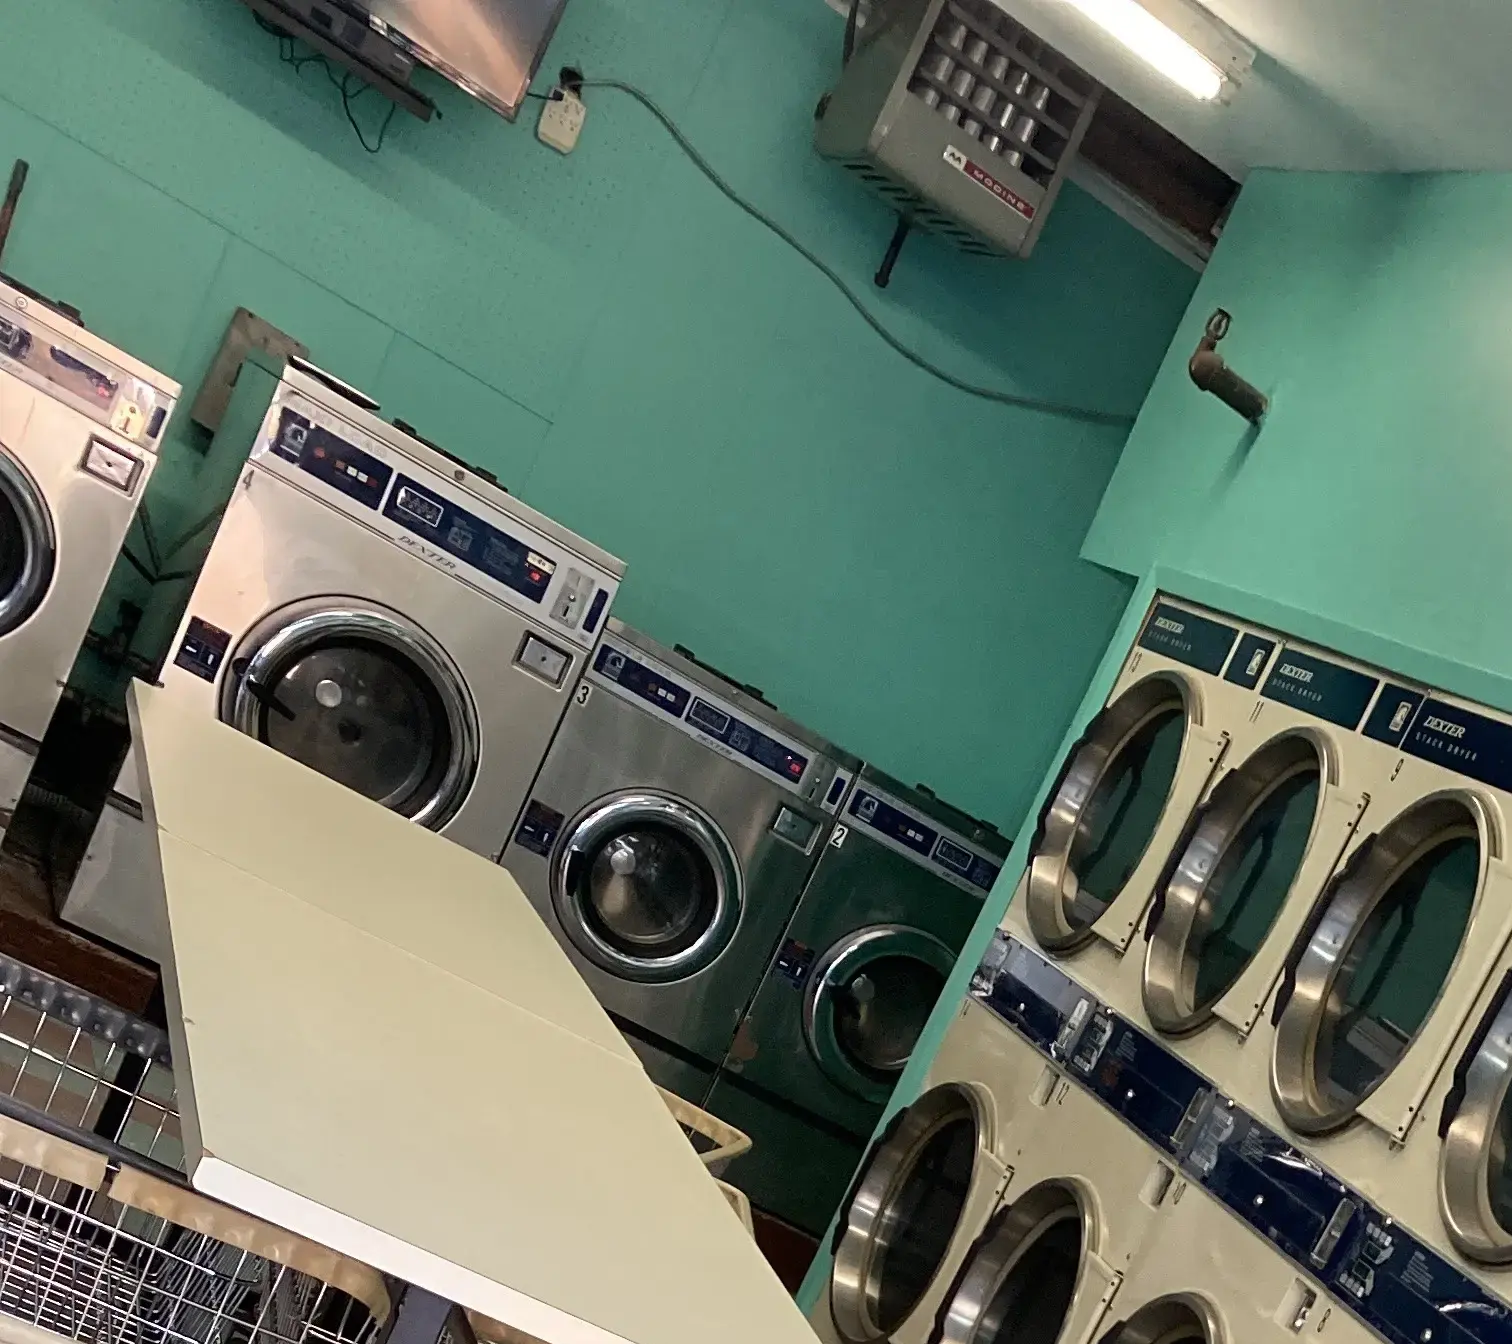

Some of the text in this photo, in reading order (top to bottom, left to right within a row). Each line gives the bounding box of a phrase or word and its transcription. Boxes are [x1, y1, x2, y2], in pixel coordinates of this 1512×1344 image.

[242, 469, 255, 490] 4
[397, 535, 457, 570] DEXTER
[1279, 664, 1314, 683] DEXTER
[576, 685, 590, 705] 3
[1423, 715, 1466, 738] DEXTER
[1390, 758, 1405, 782] 9
[832, 827, 846, 846] 2
[1316, 1308, 1332, 1333] 8
